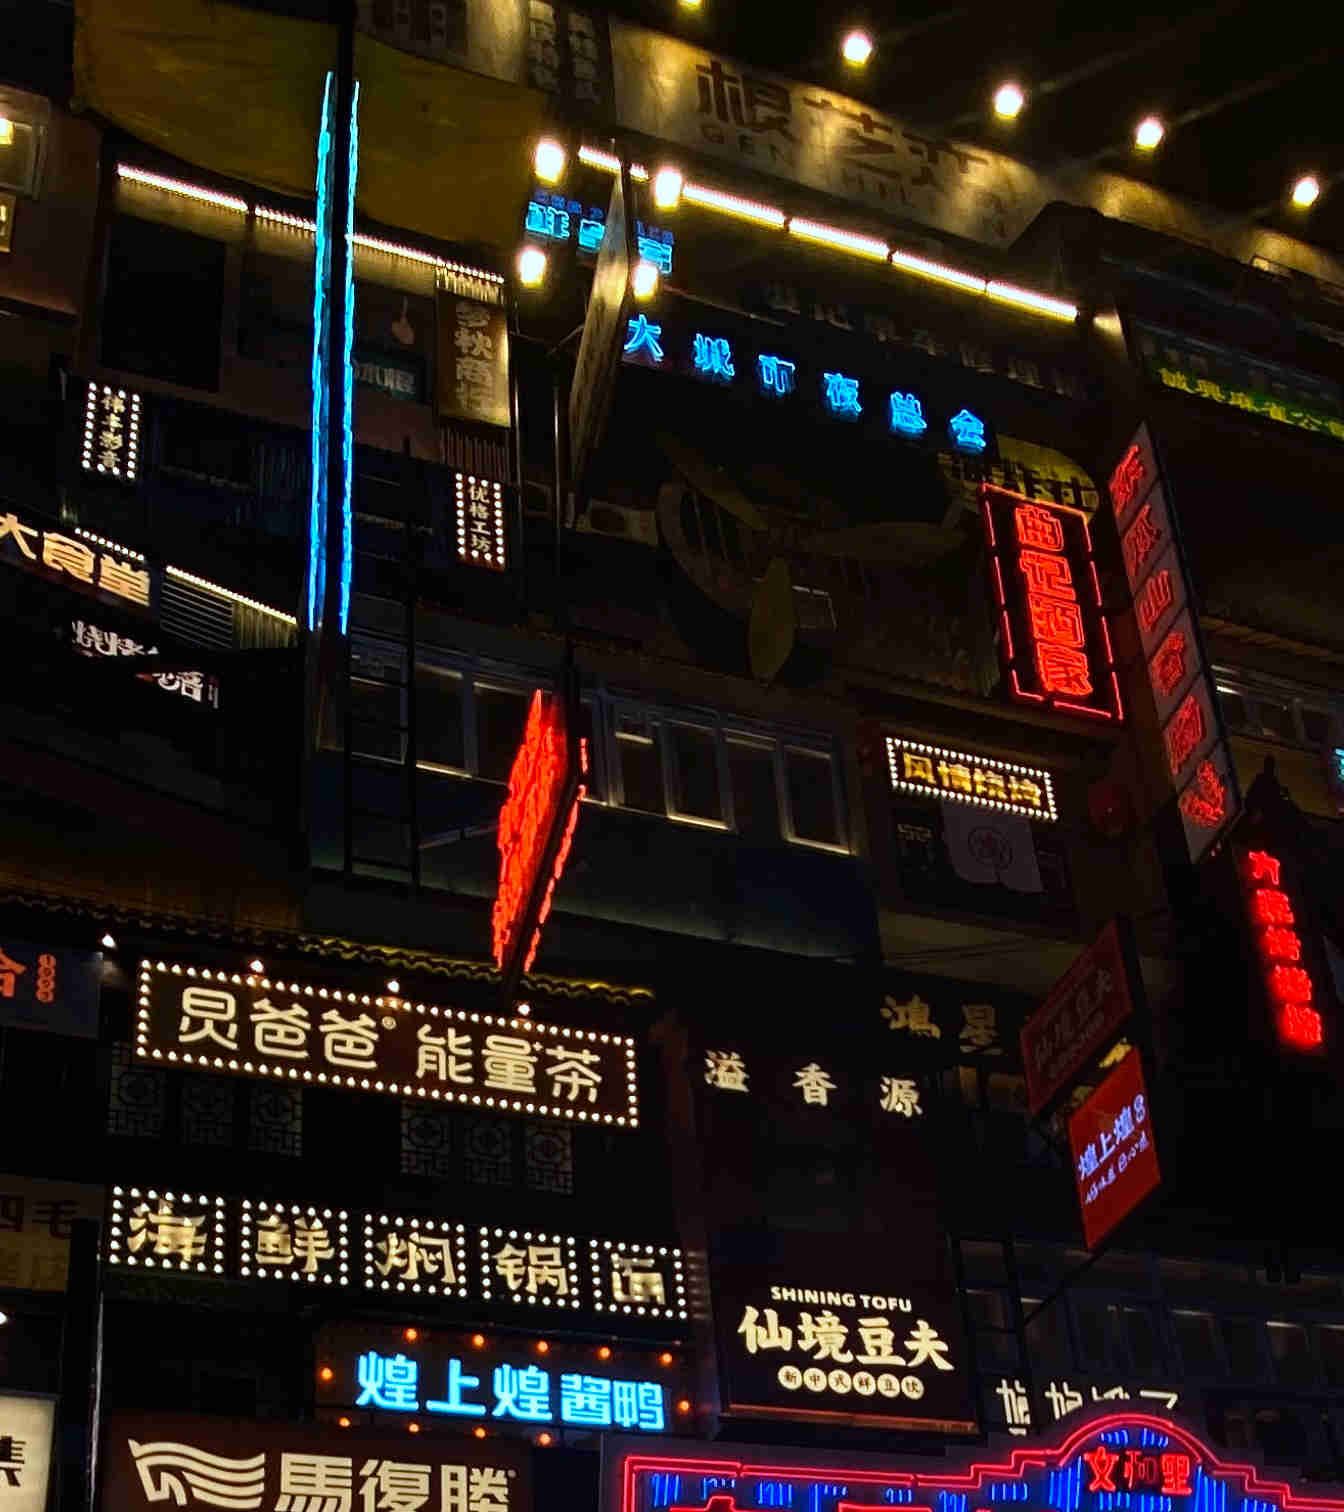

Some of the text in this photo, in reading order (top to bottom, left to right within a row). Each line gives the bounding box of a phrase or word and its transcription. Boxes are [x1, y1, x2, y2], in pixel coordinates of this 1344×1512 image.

[414, 1023, 602, 1104] 能量茶
[770, 1286, 912, 1313] SHINING TOFU
[736, 1304, 955, 1372] 仙境豆夫
[355, 1350, 666, 1433] 煌上煌酱鸭
